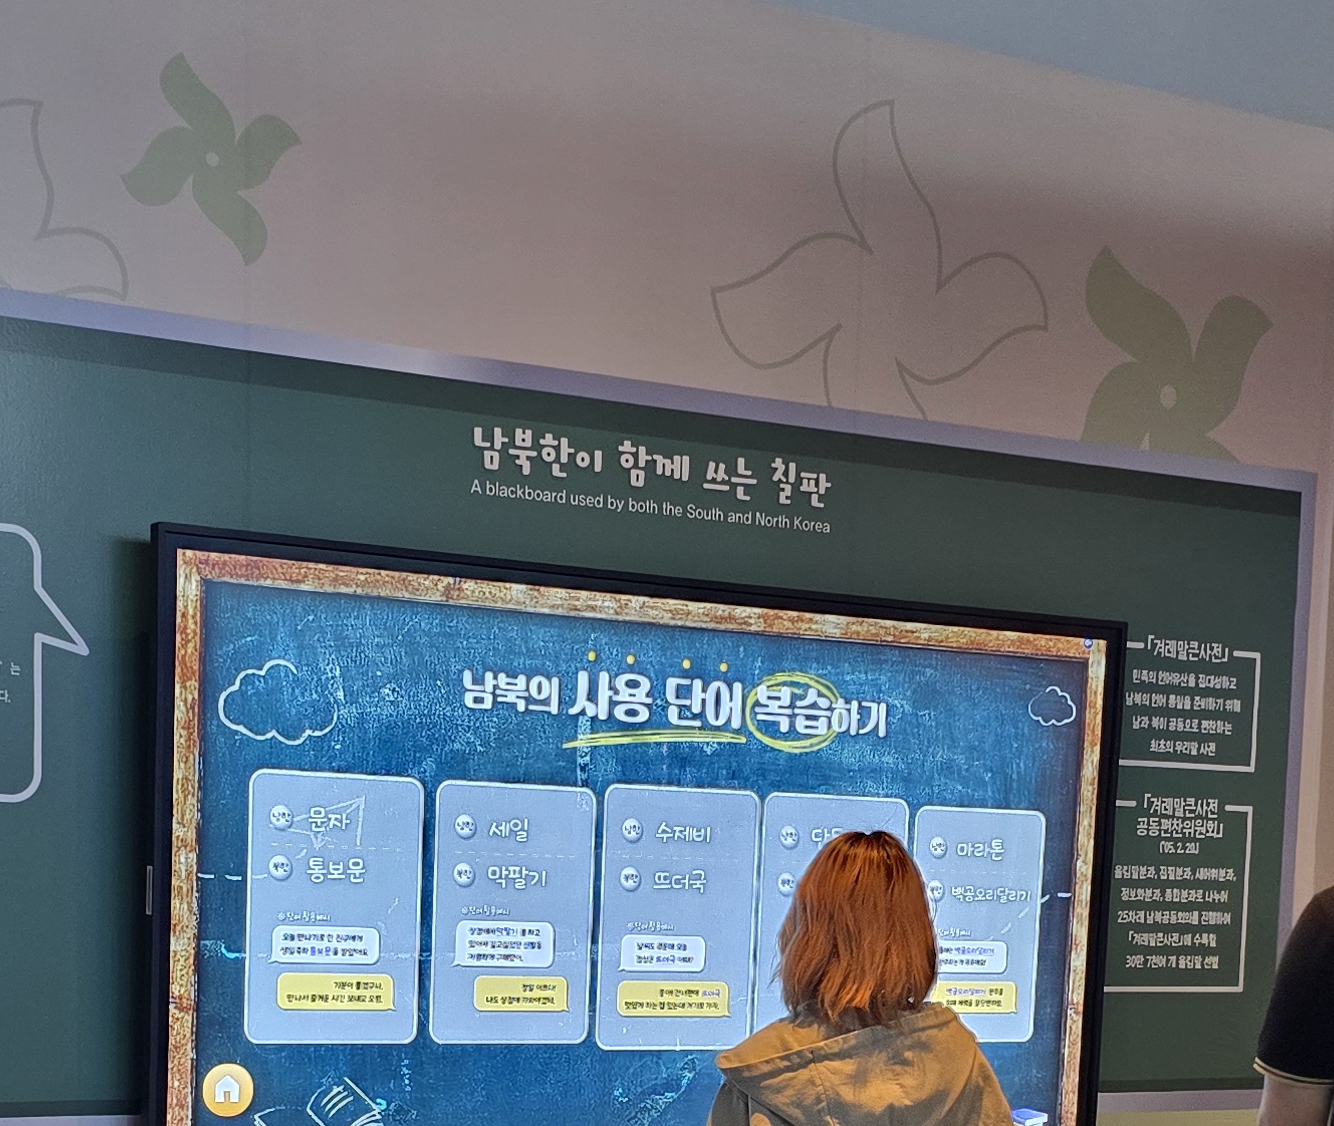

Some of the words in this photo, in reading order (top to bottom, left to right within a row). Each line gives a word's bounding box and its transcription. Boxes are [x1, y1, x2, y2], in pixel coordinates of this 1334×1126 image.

[473, 426, 603, 478] 남북한이
[617, 440, 691, 488] 함께
[702, 457, 758, 502] 쓰는
[770, 457, 832, 509] 칠판
[471, 479, 482, 495] A
[485, 481, 566, 505] blackboard
[570, 493, 604, 509] used
[607, 497, 625, 515] by
[628, 498, 658, 515] both
[662, 502, 683, 518] the
[686, 505, 724, 522] South
[727, 509, 753, 525] and
[755, 512, 790, 529] North
[794, 516, 831, 533] Korea
[462, 670, 561, 715] 남북의
[568, 670, 654, 725] 사용
[666, 676, 743, 730] 단어
[753, 683, 888, 738] 복습하기
[308, 806, 351, 832] 문자
[488, 818, 529, 842] 세일
[1136, 817, 1224, 838] 공동편찬위원회」
[655, 821, 711, 843] 수제비
[956, 839, 1005, 861] 마라톤
[306, 856, 367, 884] 통보문
[487, 865, 547, 889] 막팔기
[653, 869, 707, 894] 뜨더국
